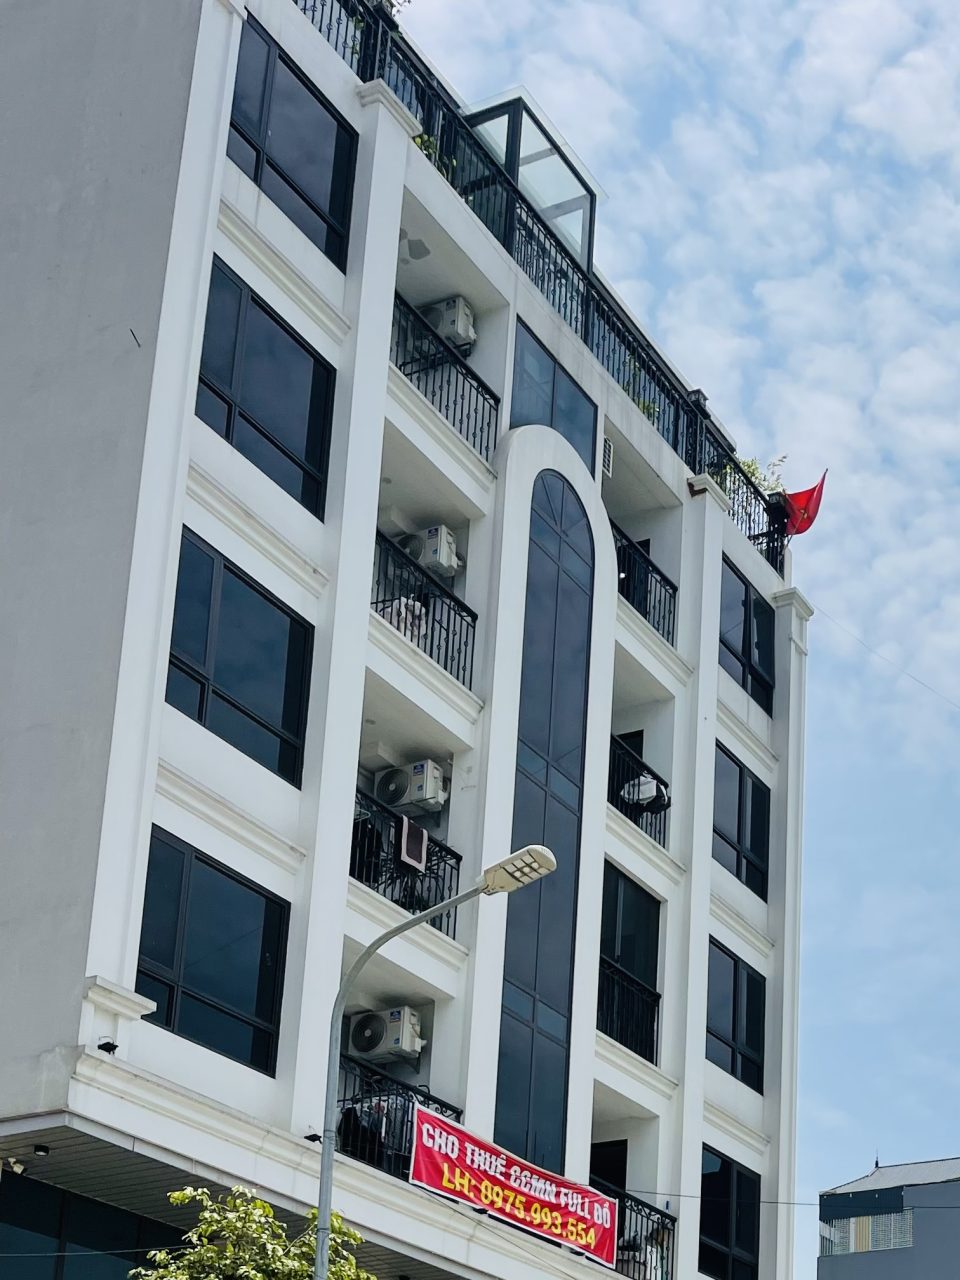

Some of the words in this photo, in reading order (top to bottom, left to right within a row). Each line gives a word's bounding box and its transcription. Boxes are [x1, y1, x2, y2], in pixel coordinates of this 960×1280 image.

[421, 1123, 460, 1159] CHO
[464, 1143, 507, 1181] THUÊ
[559, 1187, 591, 1220] FULL
